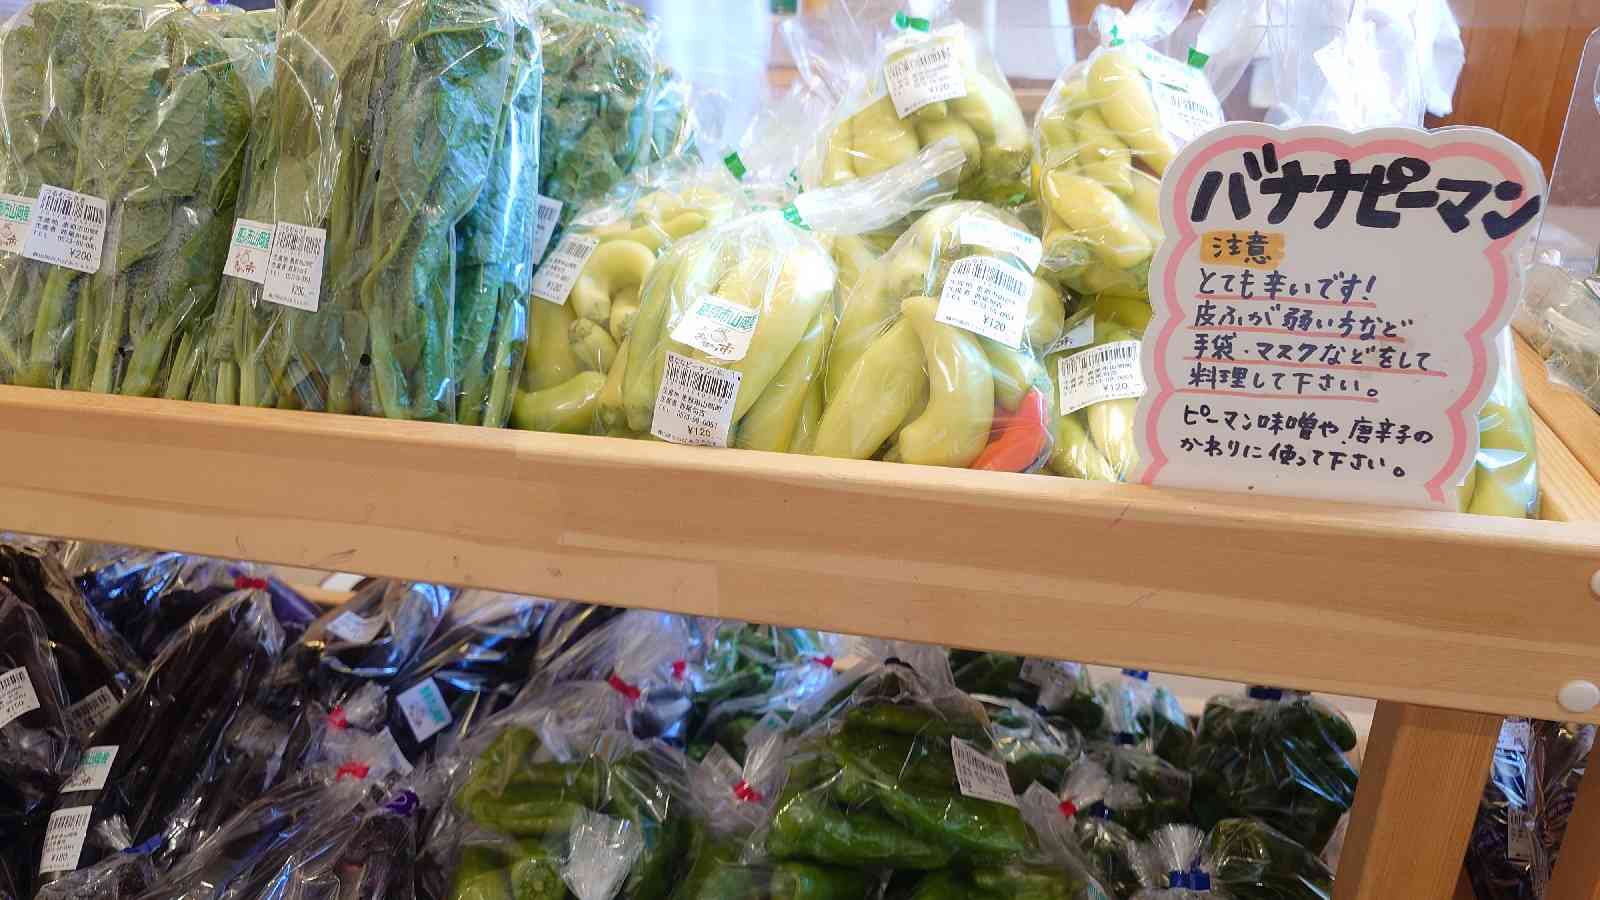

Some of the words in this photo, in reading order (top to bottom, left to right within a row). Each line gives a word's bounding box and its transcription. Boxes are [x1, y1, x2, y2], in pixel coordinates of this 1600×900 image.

[1190, 143, 1541, 240] バナナピーマン
[70, 247, 93, 262] ¥200
[1212, 230, 1272, 264] 注意
[983, 315, 1007, 333] ¥120
[1103, 382, 1128, 393] ¥120
[1188, 362, 1378, 398] 料理して下さい。
[686, 424, 712, 438] ¥120
[1180, 435, 1406, 478] かわりに使って下さい。
